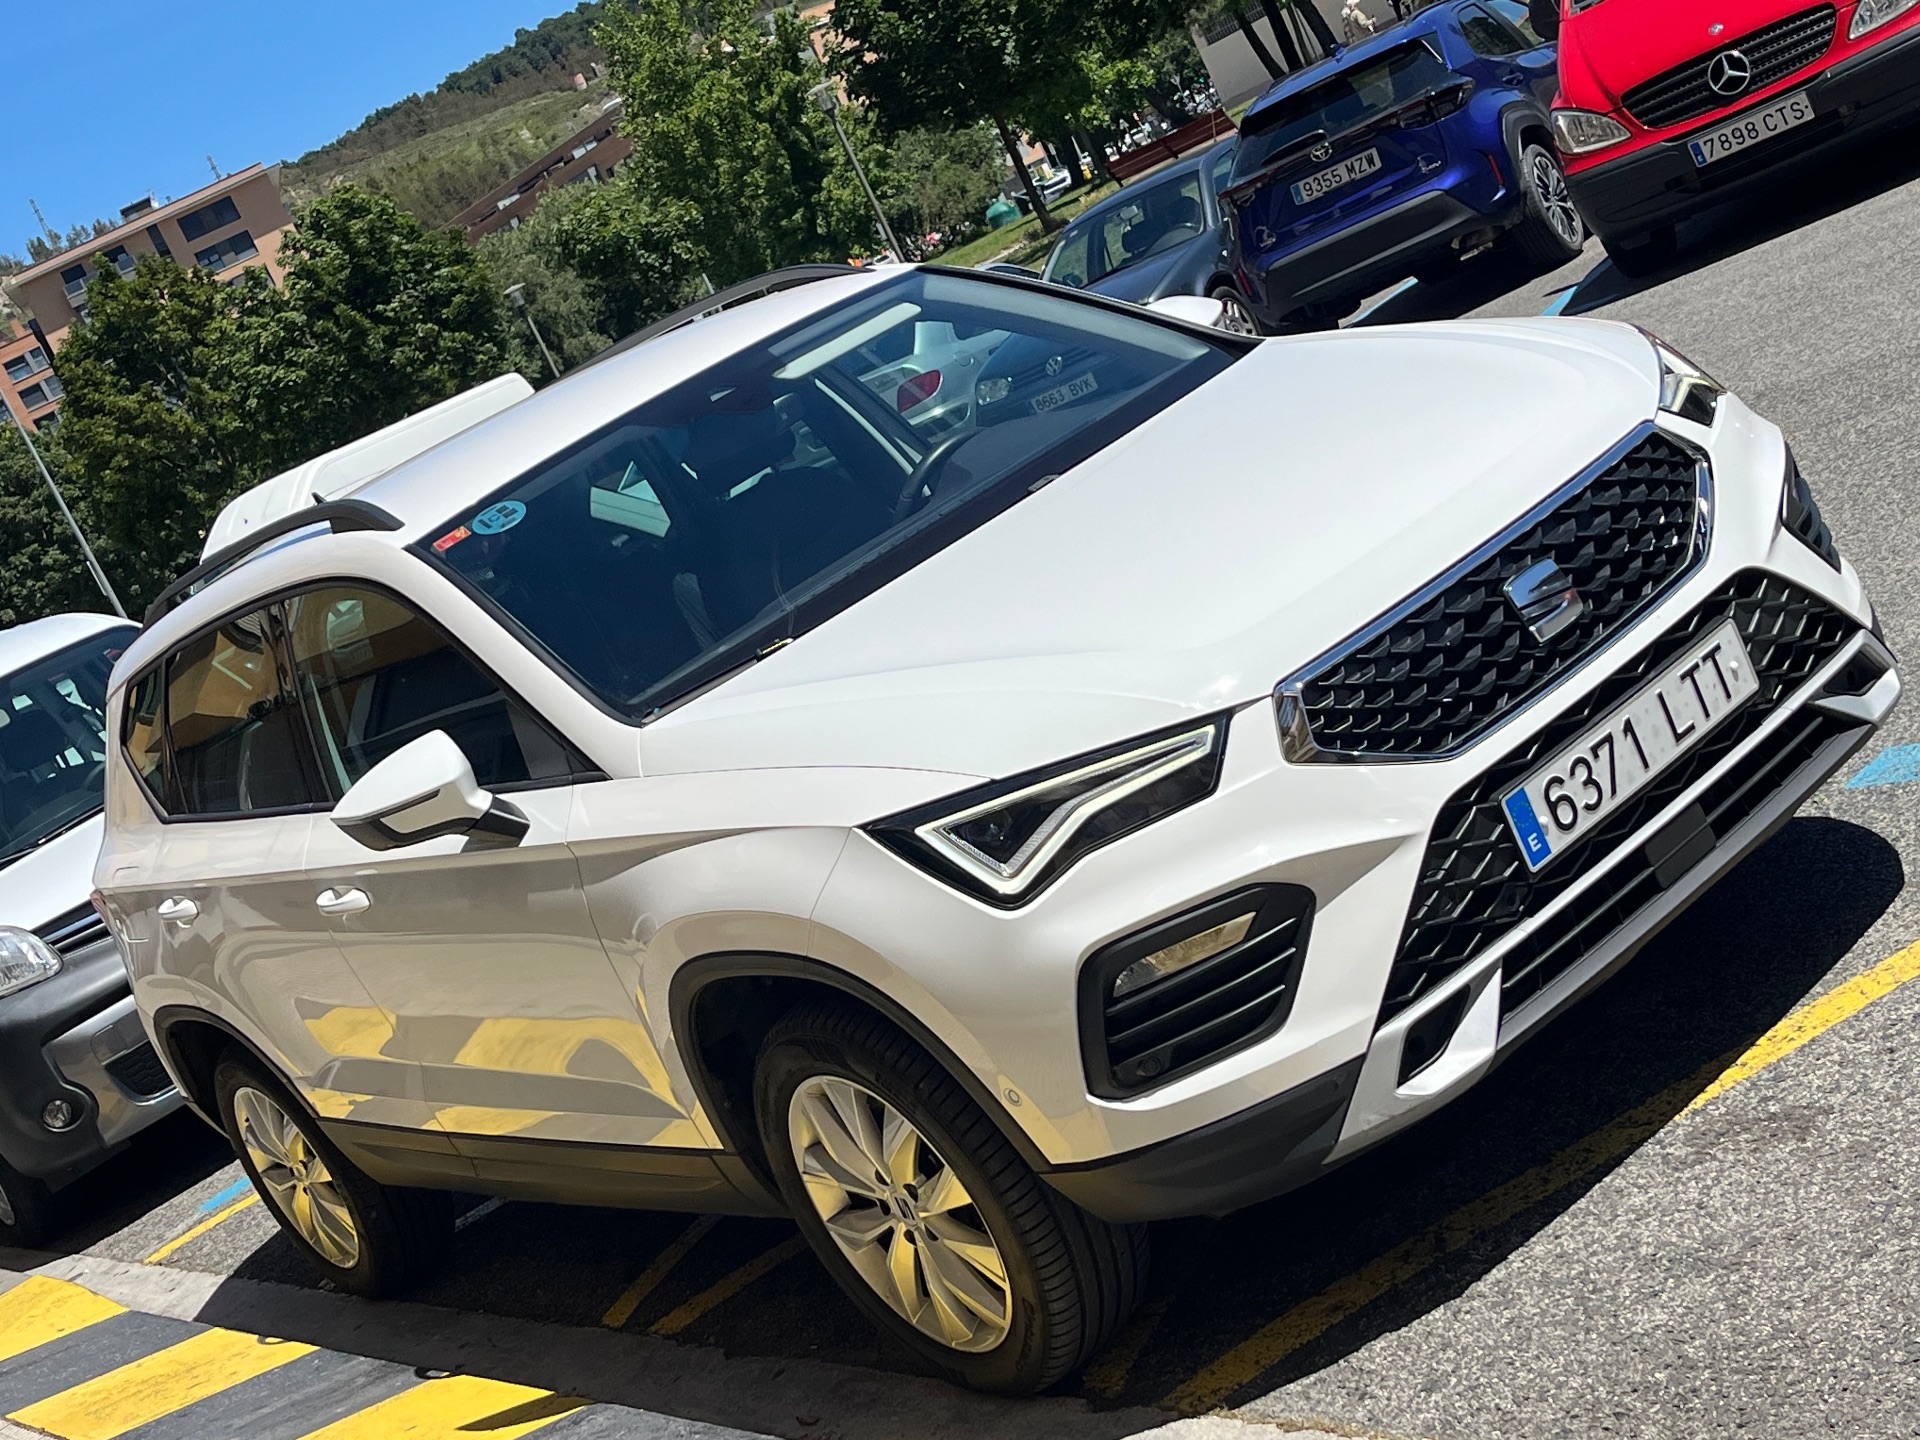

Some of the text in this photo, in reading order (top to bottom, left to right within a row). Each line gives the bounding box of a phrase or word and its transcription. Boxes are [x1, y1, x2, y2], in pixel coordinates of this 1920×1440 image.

[1703, 101, 1805, 159] 7898 CTS
[1303, 152, 1376, 197] 9355 MZW
[1035, 378, 1094, 411] 8663 BVK
[1542, 640, 1732, 833] 6371 LTT
[1527, 832, 1542, 853] E
